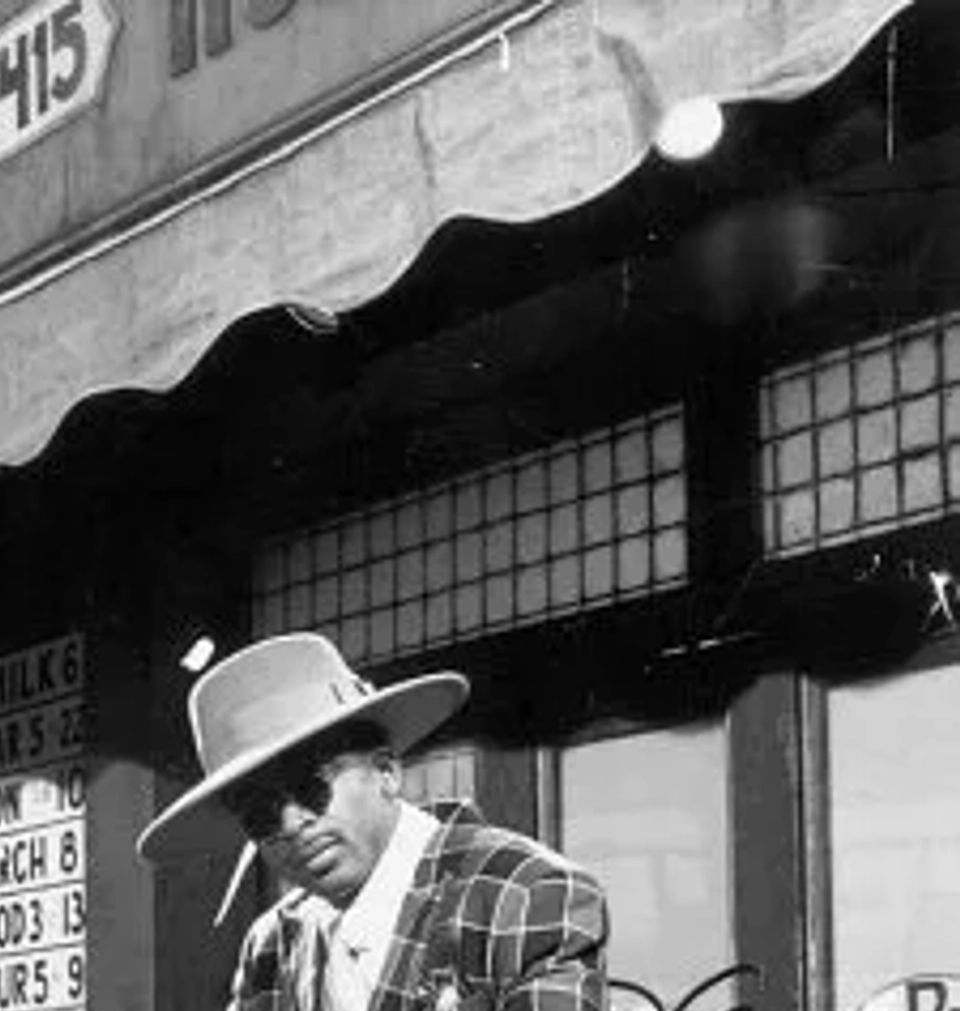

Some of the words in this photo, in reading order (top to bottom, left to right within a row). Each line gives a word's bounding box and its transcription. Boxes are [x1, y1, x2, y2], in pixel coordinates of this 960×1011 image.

[63, 642, 78, 684] 6
[60, 831, 78, 873] 8
[62, 890, 87, 937] 13
[68, 954, 83, 999] 9
